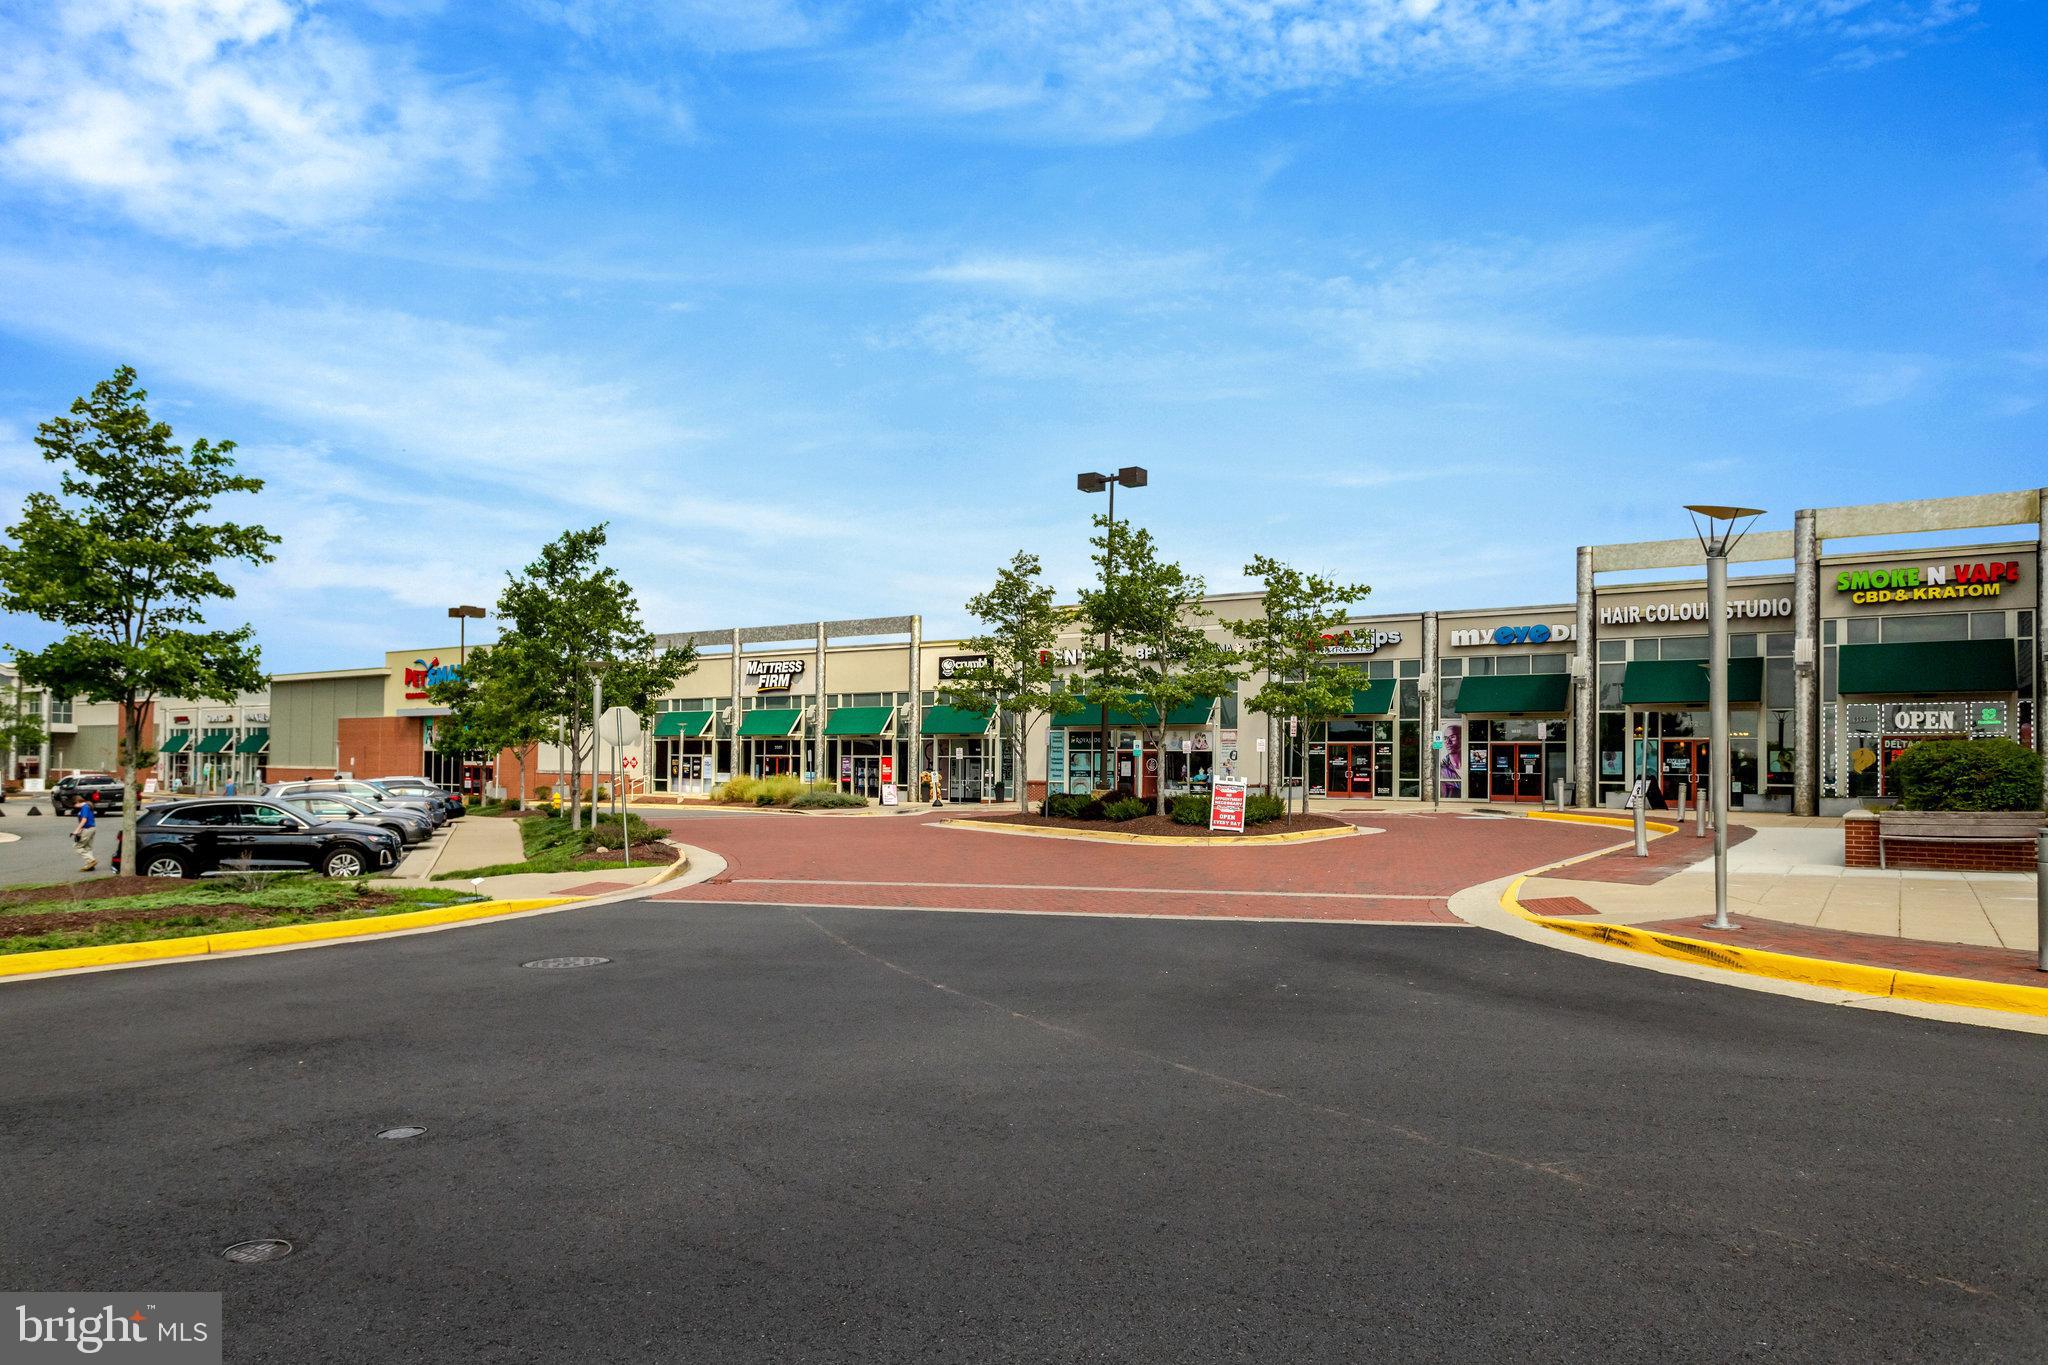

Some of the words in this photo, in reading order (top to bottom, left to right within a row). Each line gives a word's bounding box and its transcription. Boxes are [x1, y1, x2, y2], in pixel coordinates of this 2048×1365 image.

[1837, 567, 1921, 591] SMOKE
[1927, 565, 1947, 586] N
[1953, 561, 2020, 584] VAPE
[1852, 590, 1892, 605] CBD
[1894, 589, 1909, 601] &
[1913, 583, 2000, 600] KRATOM
[1600, 605, 1641, 625] HAIR
[1645, 602, 1709, 622] COLOU
[746, 660, 803, 675] MATTRESS
[758, 673, 791, 688] FIRM
[1894, 711, 1955, 730] OPEN
